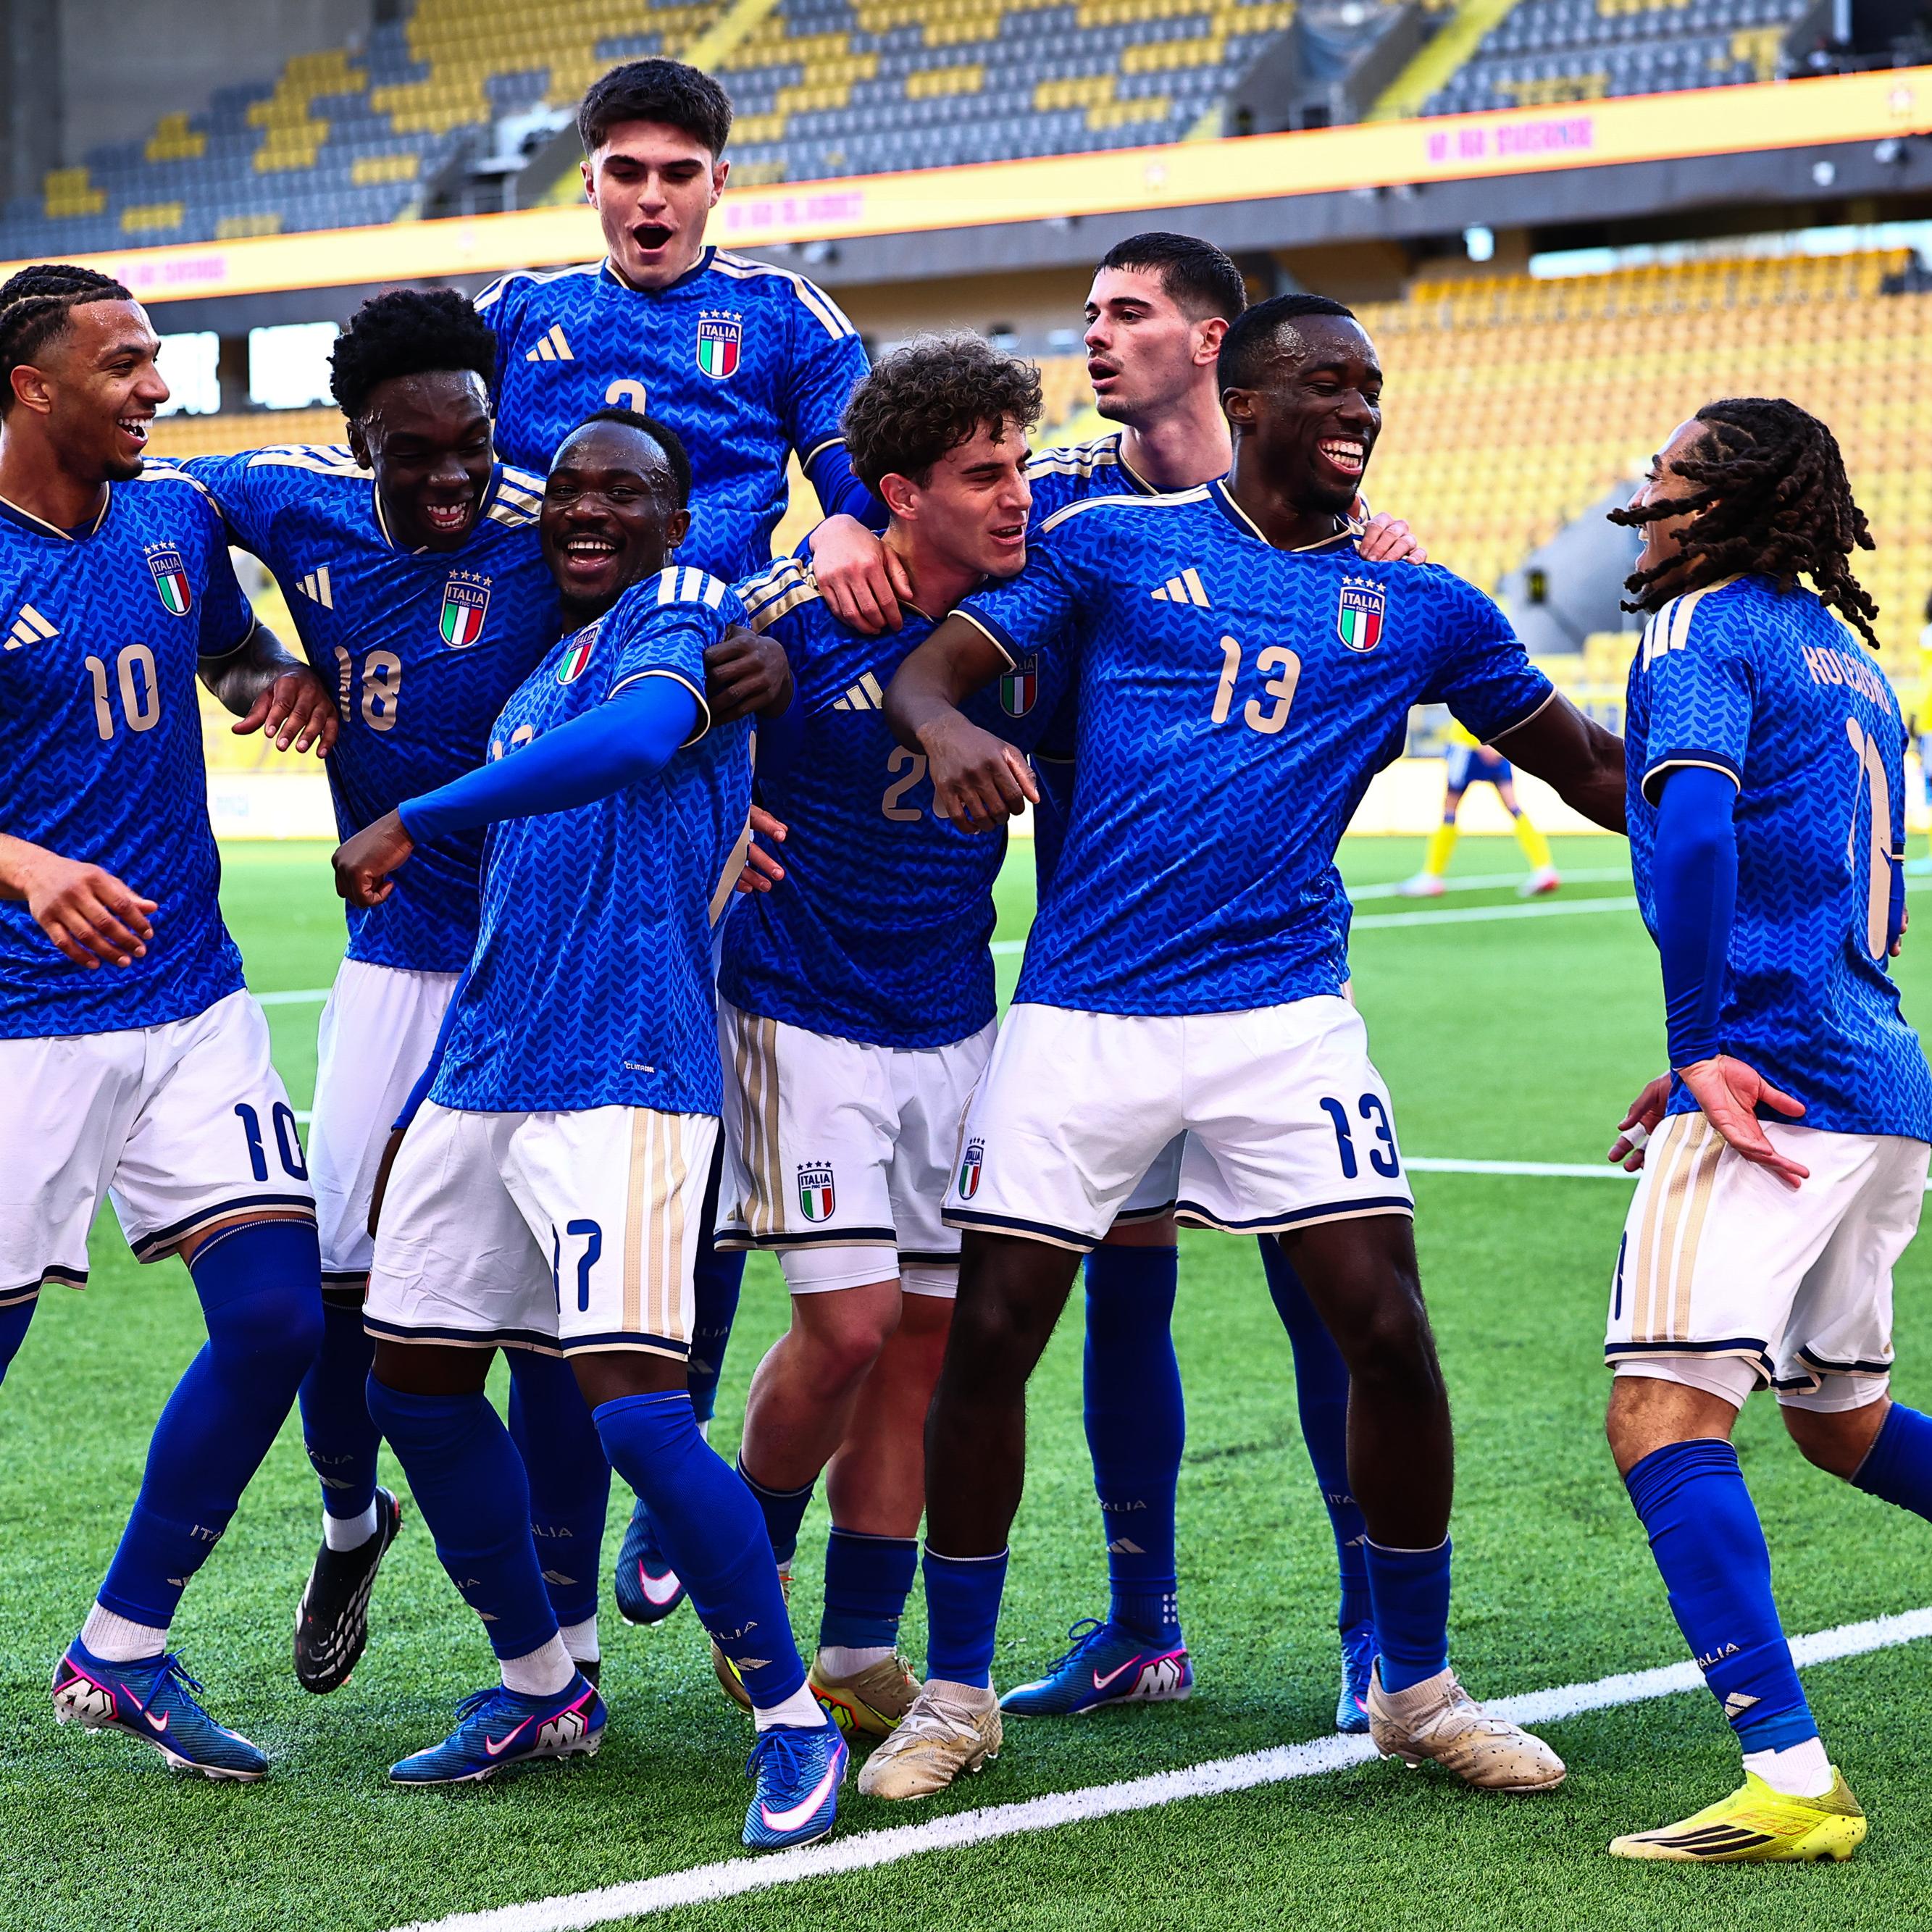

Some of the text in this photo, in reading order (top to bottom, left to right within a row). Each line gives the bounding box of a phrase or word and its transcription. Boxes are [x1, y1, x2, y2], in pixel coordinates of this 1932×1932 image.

[701, 325, 737, 338] ITALIA
[151, 557, 180, 572] ITALIA
[448, 586, 484, 604] ITALIA
[1344, 592, 1381, 611] ITALIA
[85, 643, 160, 740] 10
[335, 645, 401, 731] 18
[1210, 635, 1301, 735] 13
[234, 1102, 309, 1182] 10
[1319, 1092, 1400, 1179] 13
[800, 1174, 830, 1186] ITALIA
[1697, 1642, 1740, 1670] ALIA
